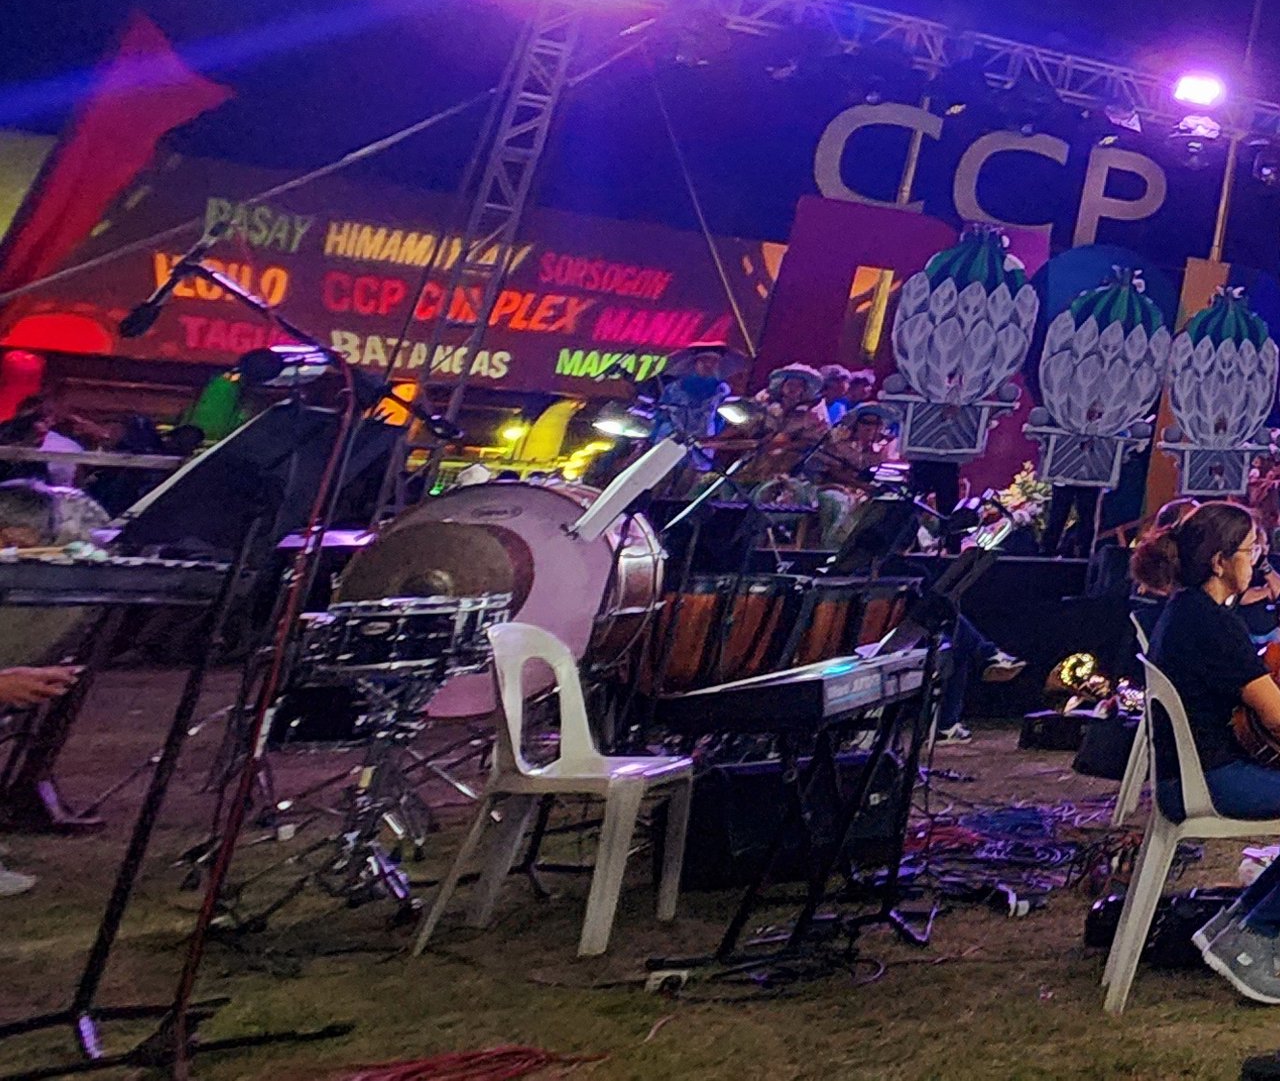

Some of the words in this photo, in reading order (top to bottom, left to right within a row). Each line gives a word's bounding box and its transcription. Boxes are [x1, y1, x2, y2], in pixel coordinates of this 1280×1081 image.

[814, 102, 1167, 248] CCP
[205, 197, 315, 253] PASAY
[322, 271, 408, 316] CCP
[412, 281, 598, 334] CMPLEX
[591, 306, 734, 347] MANILA
[331, 330, 513, 380] BATANGAS
[554, 348, 668, 383] MAKATI
